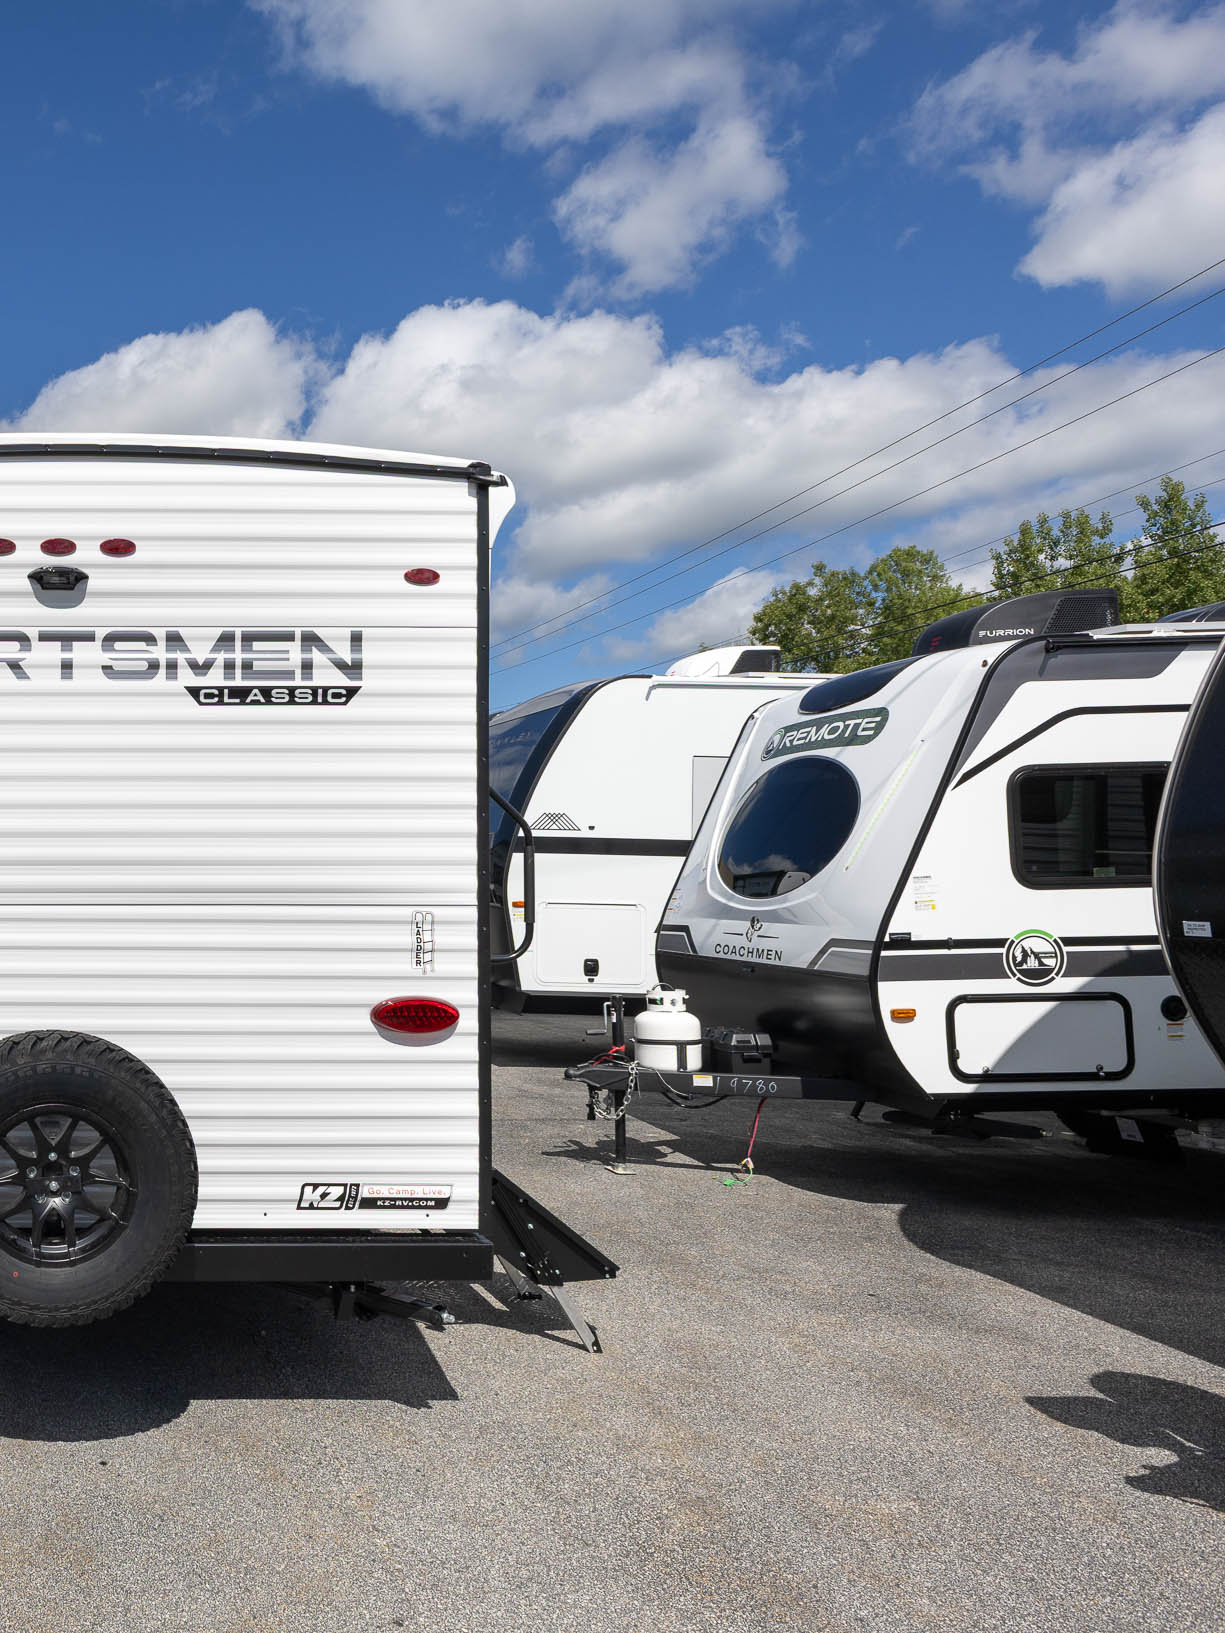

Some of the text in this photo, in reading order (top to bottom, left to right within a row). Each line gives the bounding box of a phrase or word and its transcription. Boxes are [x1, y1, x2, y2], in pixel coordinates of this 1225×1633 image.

[978, 628, 1034, 638] FURRION
[199, 688, 347, 703] CLASSIC
[779, 716, 881, 749] REMOTE
[714, 943, 783, 961] COACHMEN
[300, 1186, 344, 1208] KZ
[367, 1187, 446, 1196] Go. Camp. Live.
